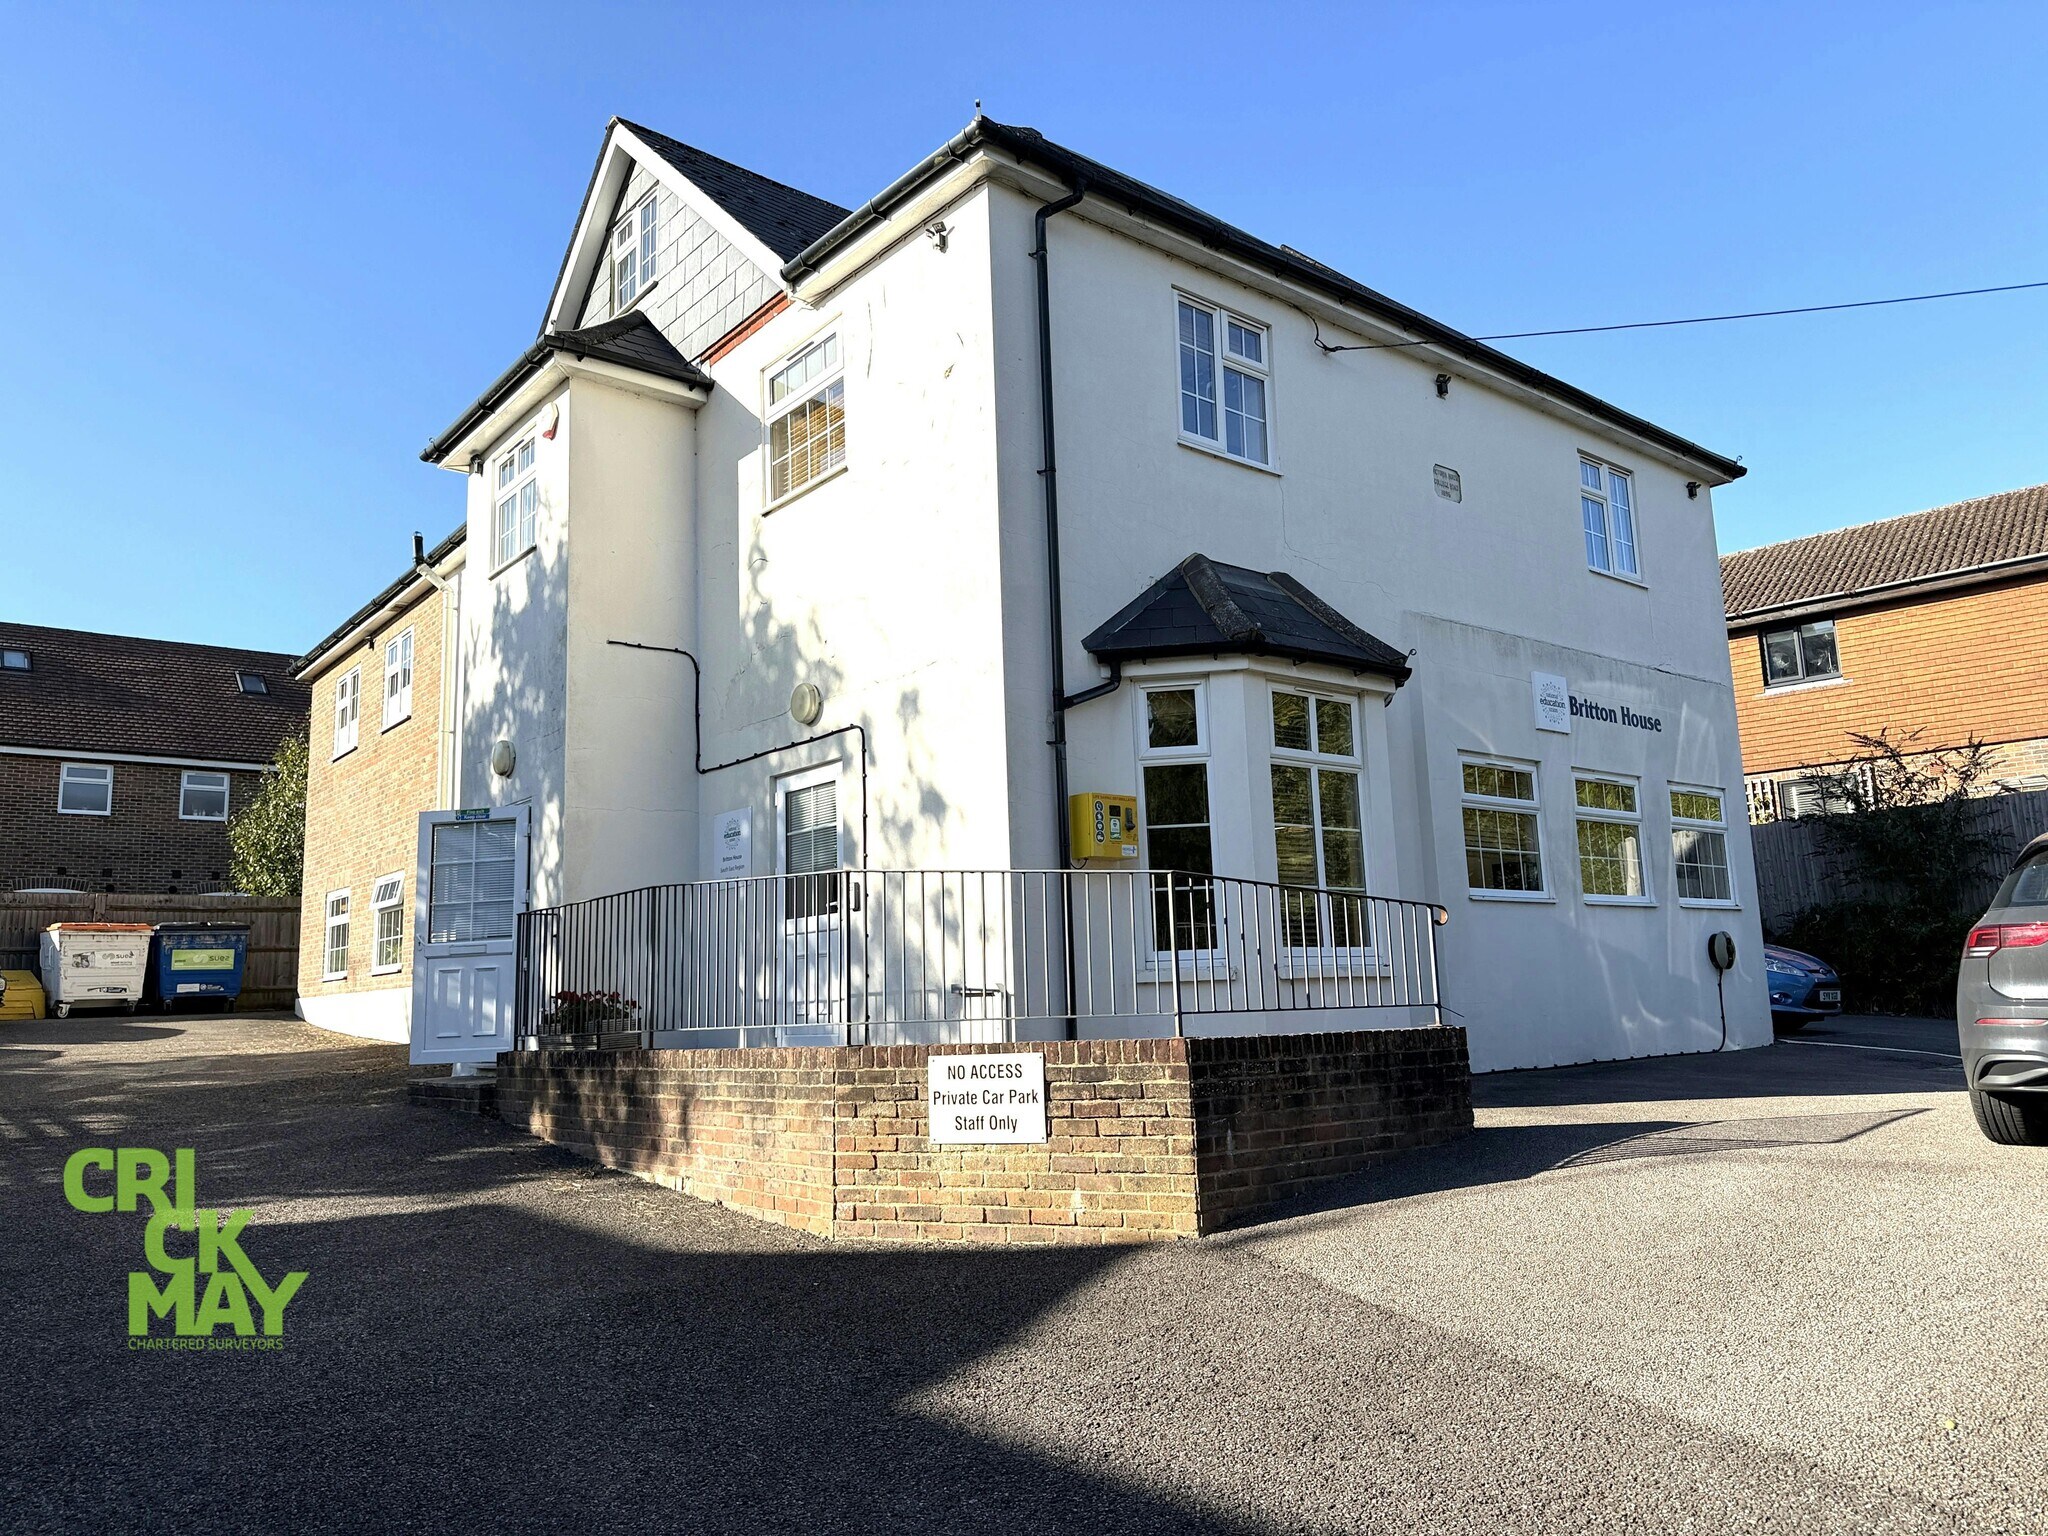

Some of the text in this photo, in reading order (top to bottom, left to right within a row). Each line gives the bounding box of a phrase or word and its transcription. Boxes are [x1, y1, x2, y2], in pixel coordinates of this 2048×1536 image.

[1539, 697, 1566, 709] education
[1569, 695, 1662, 732] Britton House
[723, 830, 741, 839] education
[947, 1063, 1023, 1080] NO ACCESS
[933, 1089, 1039, 1105] Private Car Park
[955, 1115, 1018, 1133] Staff Only
